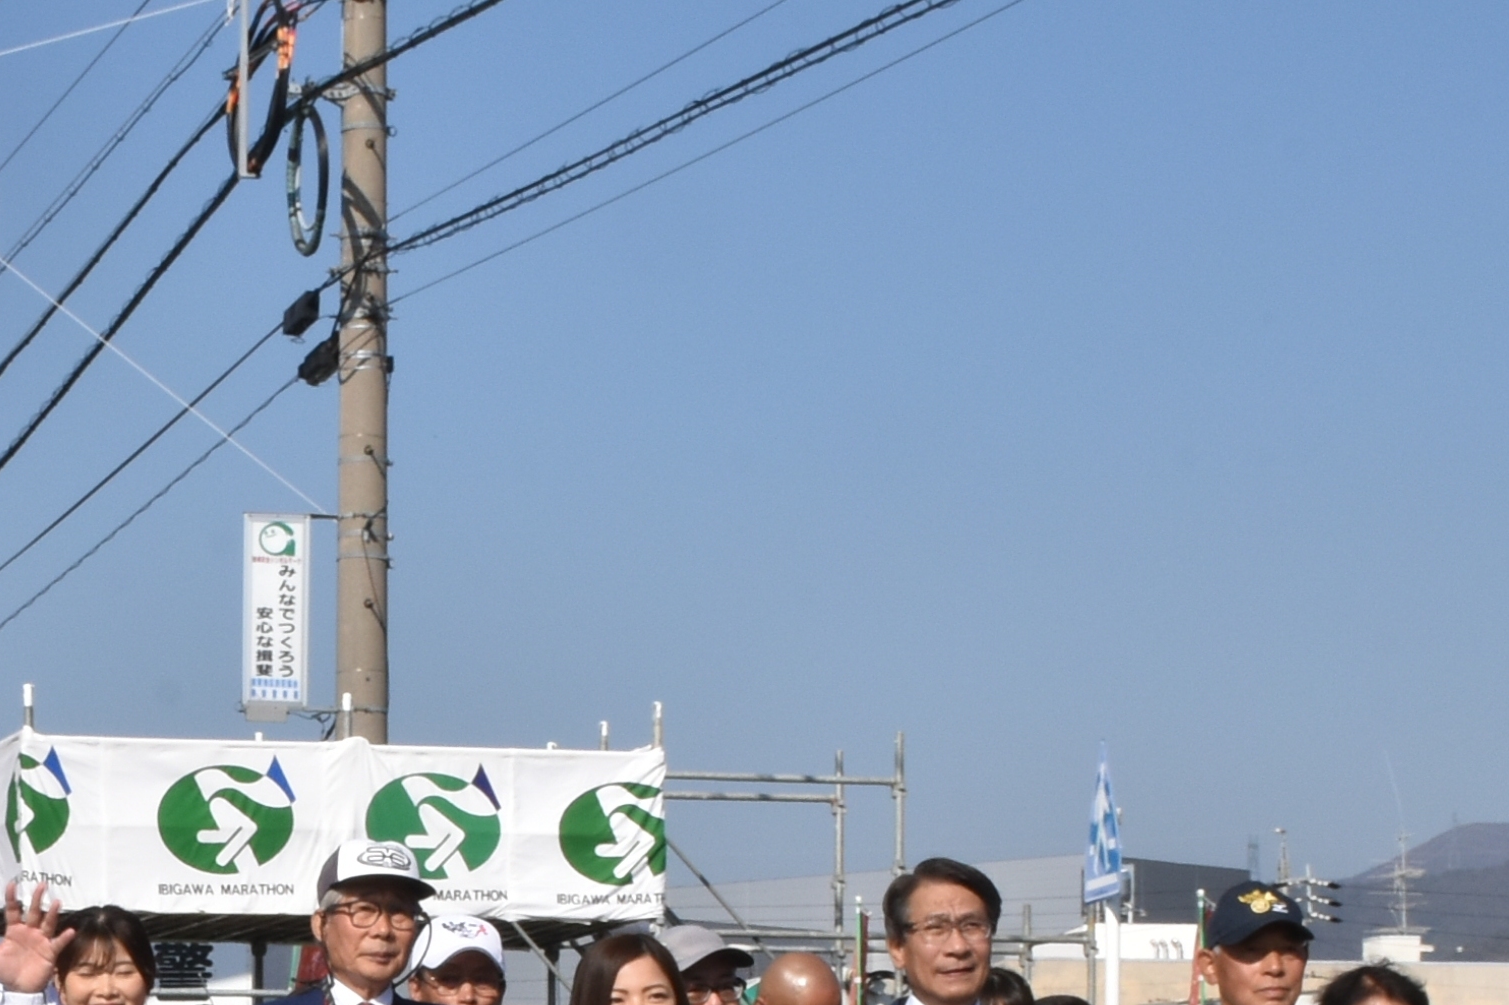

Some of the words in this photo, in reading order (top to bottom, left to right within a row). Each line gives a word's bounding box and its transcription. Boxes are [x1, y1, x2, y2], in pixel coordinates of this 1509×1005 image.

[278, 564, 296, 678] みんなでつくろう
[255, 606, 274, 677] 安心な揖斐
[157, 883, 215, 896] IBIGAWA
[220, 883, 295, 896] MARATHON
[433, 889, 508, 902] MARATHON
[556, 892, 611, 905] IBIGAWA
